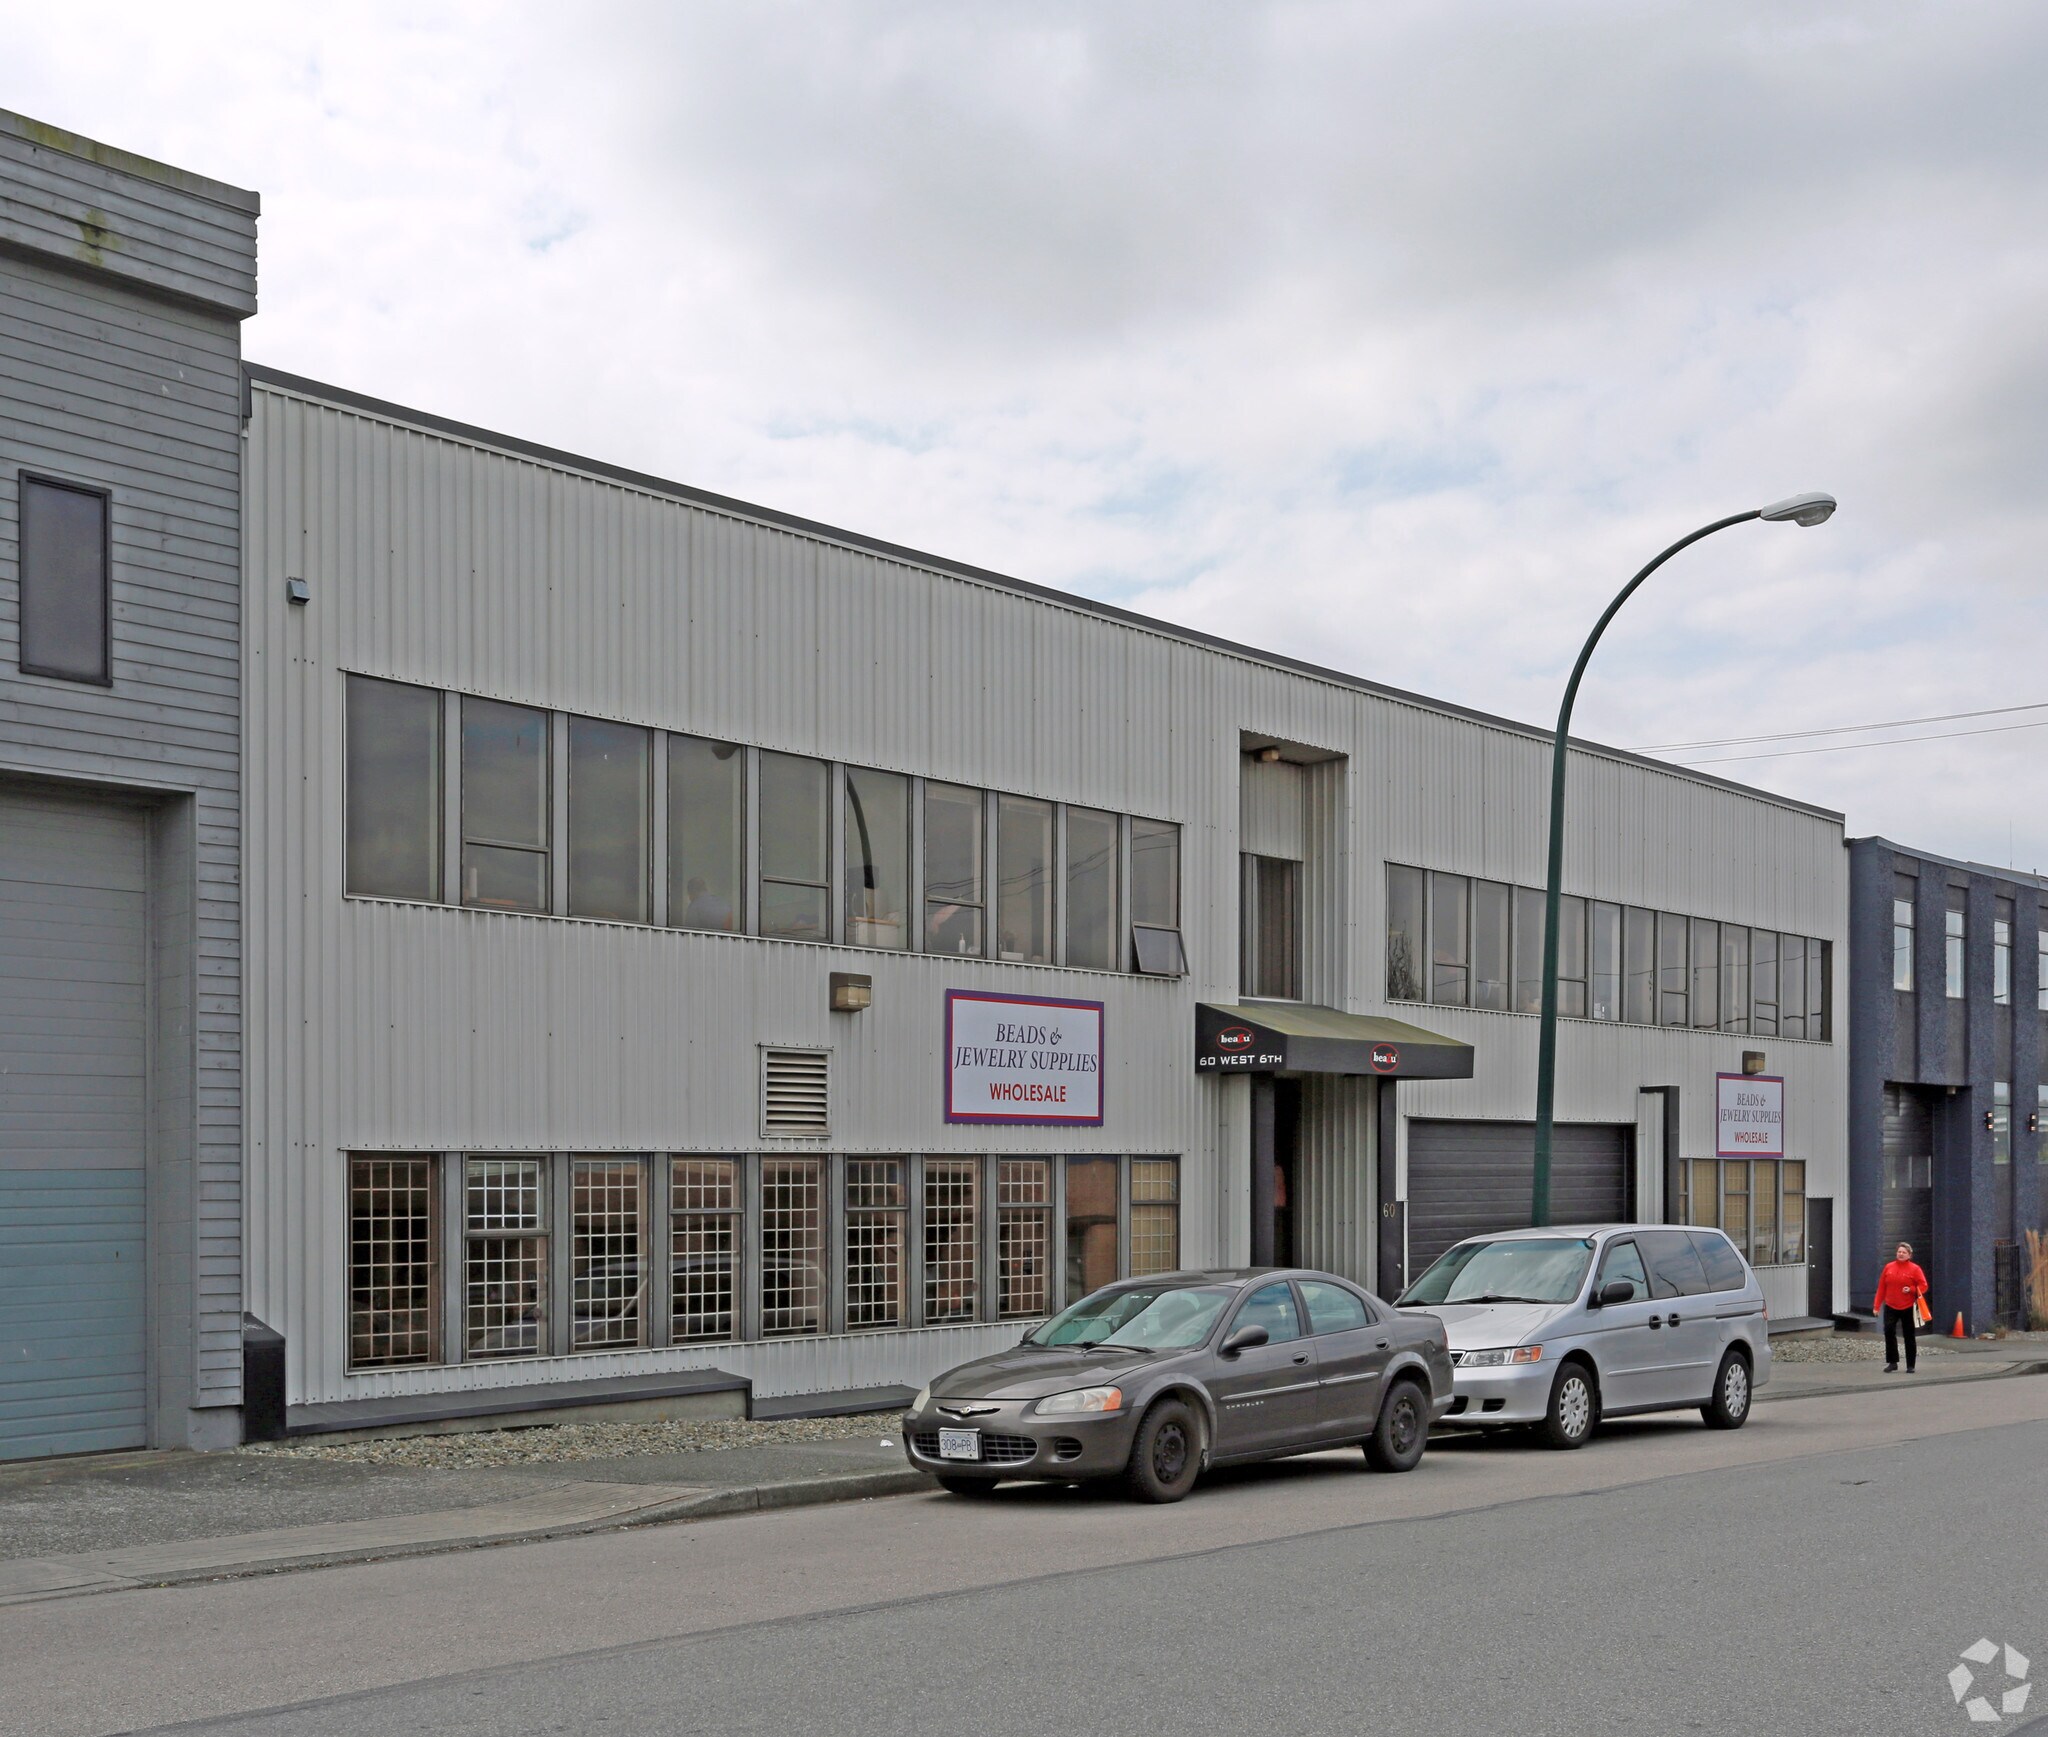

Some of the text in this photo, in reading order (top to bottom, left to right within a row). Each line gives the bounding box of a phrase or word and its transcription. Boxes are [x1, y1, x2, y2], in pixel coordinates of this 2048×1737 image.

[995, 1023, 1062, 1046] BEADS &
[954, 1046, 1097, 1073] JEWELRY SUPPLIES
[1199, 1054, 1282, 1066] 60 WEST 6TH
[989, 1083, 1067, 1102] WHOLESALE
[1736, 1093, 1759, 1106] BEADS
[1720, 1109, 1782, 1124] JEWELRY SUPPLIES
[1734, 1131, 1769, 1144] WHOLESALE
[1383, 1202, 1396, 1218] 60
